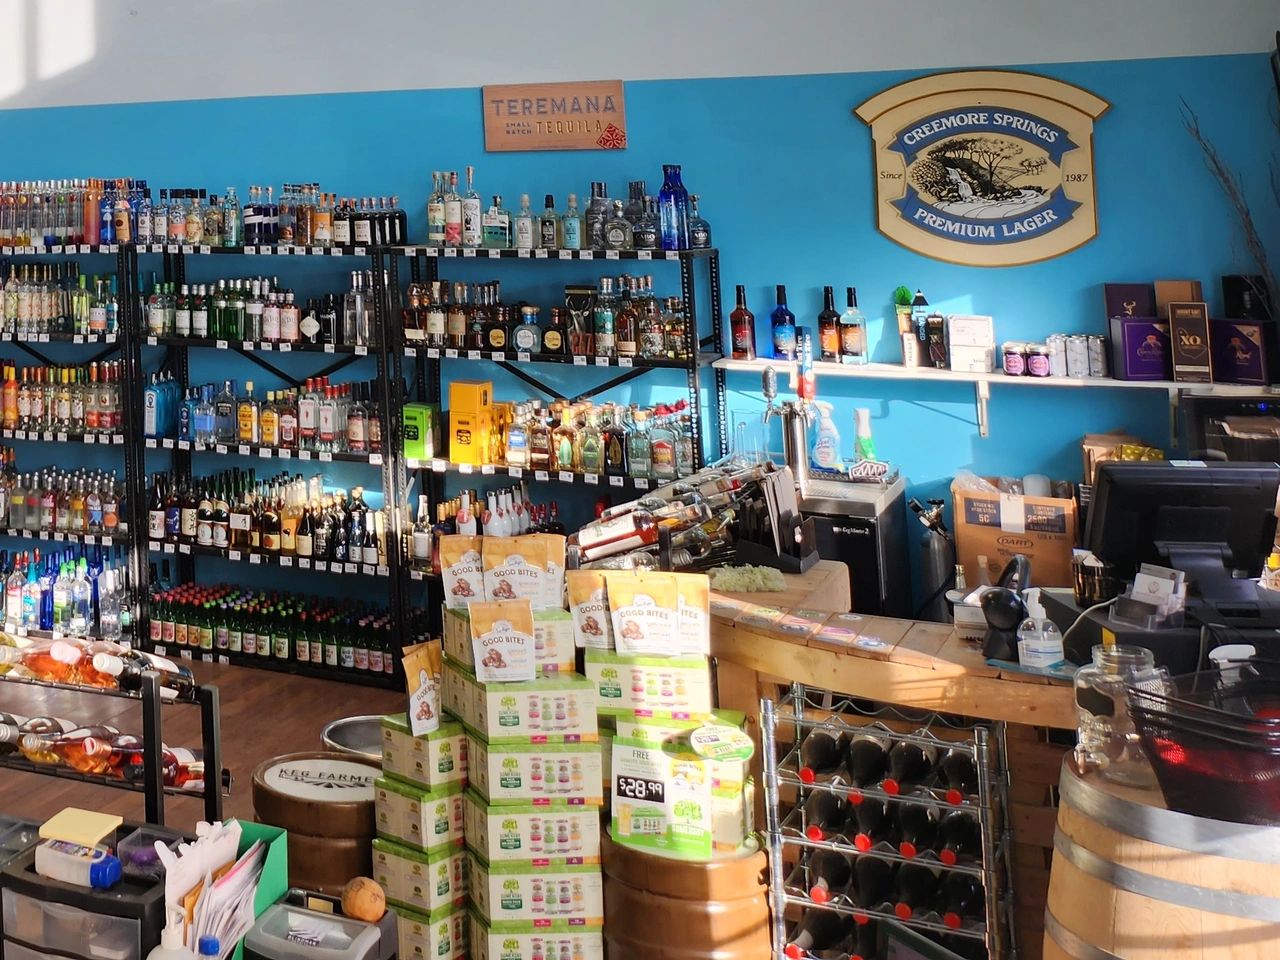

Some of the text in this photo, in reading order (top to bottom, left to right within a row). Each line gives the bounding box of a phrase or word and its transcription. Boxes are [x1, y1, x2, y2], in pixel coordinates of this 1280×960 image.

[491, 95, 617, 116] TEREMANA
[536, 119, 603, 135] TEQUILA
[903, 112, 1059, 145] CREEMORE SPRINGS
[879, 170, 904, 180] Since
[1065, 173, 1089, 183] 1987
[913, 207, 1059, 238] PREMIUM LAGER
[1180, 335, 1201, 346] XO
[452, 565, 473, 577] GOOD
[493, 567, 516, 578] GOOD
[518, 568, 538, 579] BITES
[580, 604, 602, 614] GOOD
[620, 609, 669, 620] GOOD BITES
[681, 609, 698, 620] ITES
[482, 636, 525, 647] GOOD BITES
[632, 749, 649, 760] FREE
[279, 768, 373, 783] KEG FARME
